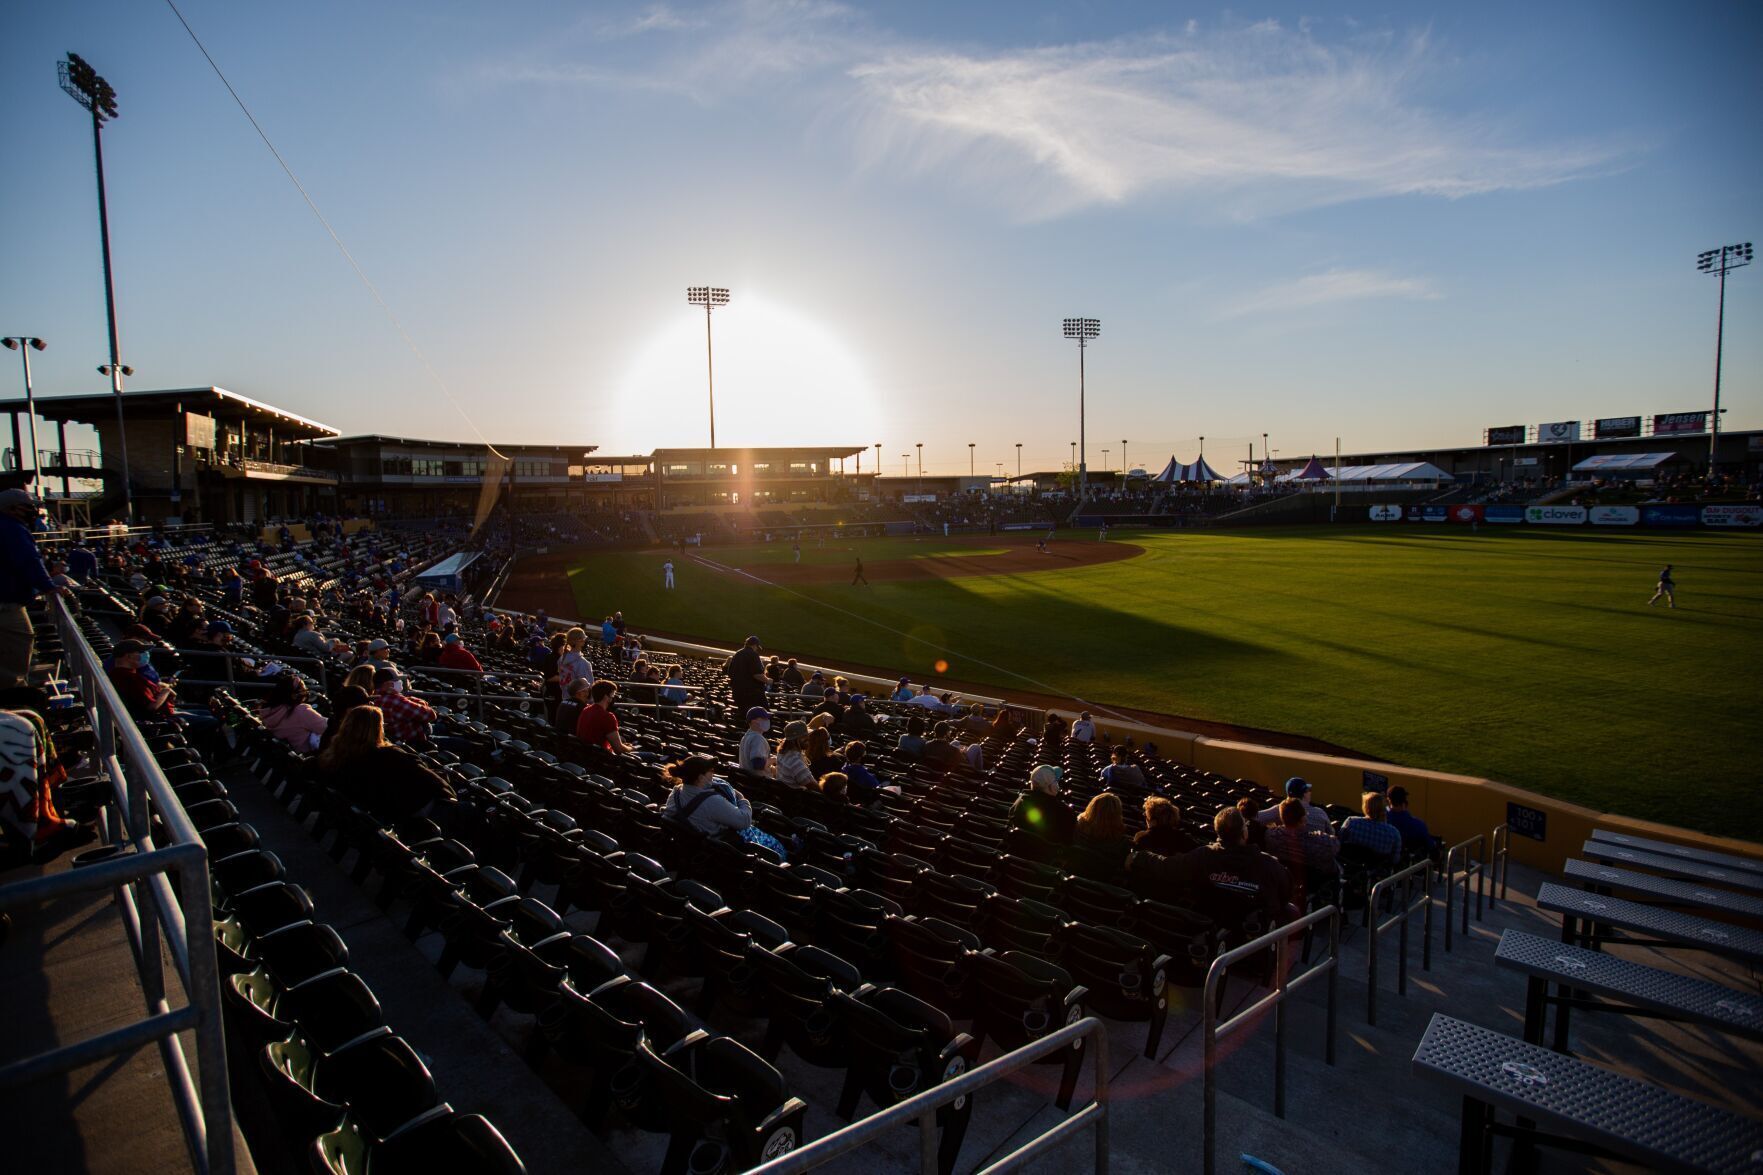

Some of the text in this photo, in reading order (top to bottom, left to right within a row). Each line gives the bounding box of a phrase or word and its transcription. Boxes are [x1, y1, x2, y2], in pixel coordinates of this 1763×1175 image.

[1600, 418, 1636, 428] HUBER
[1662, 413, 1704, 425] Jensen
[1543, 508, 1583, 519] clover
[1515, 807, 1536, 821] 100
[1516, 817, 1535, 832] 101
